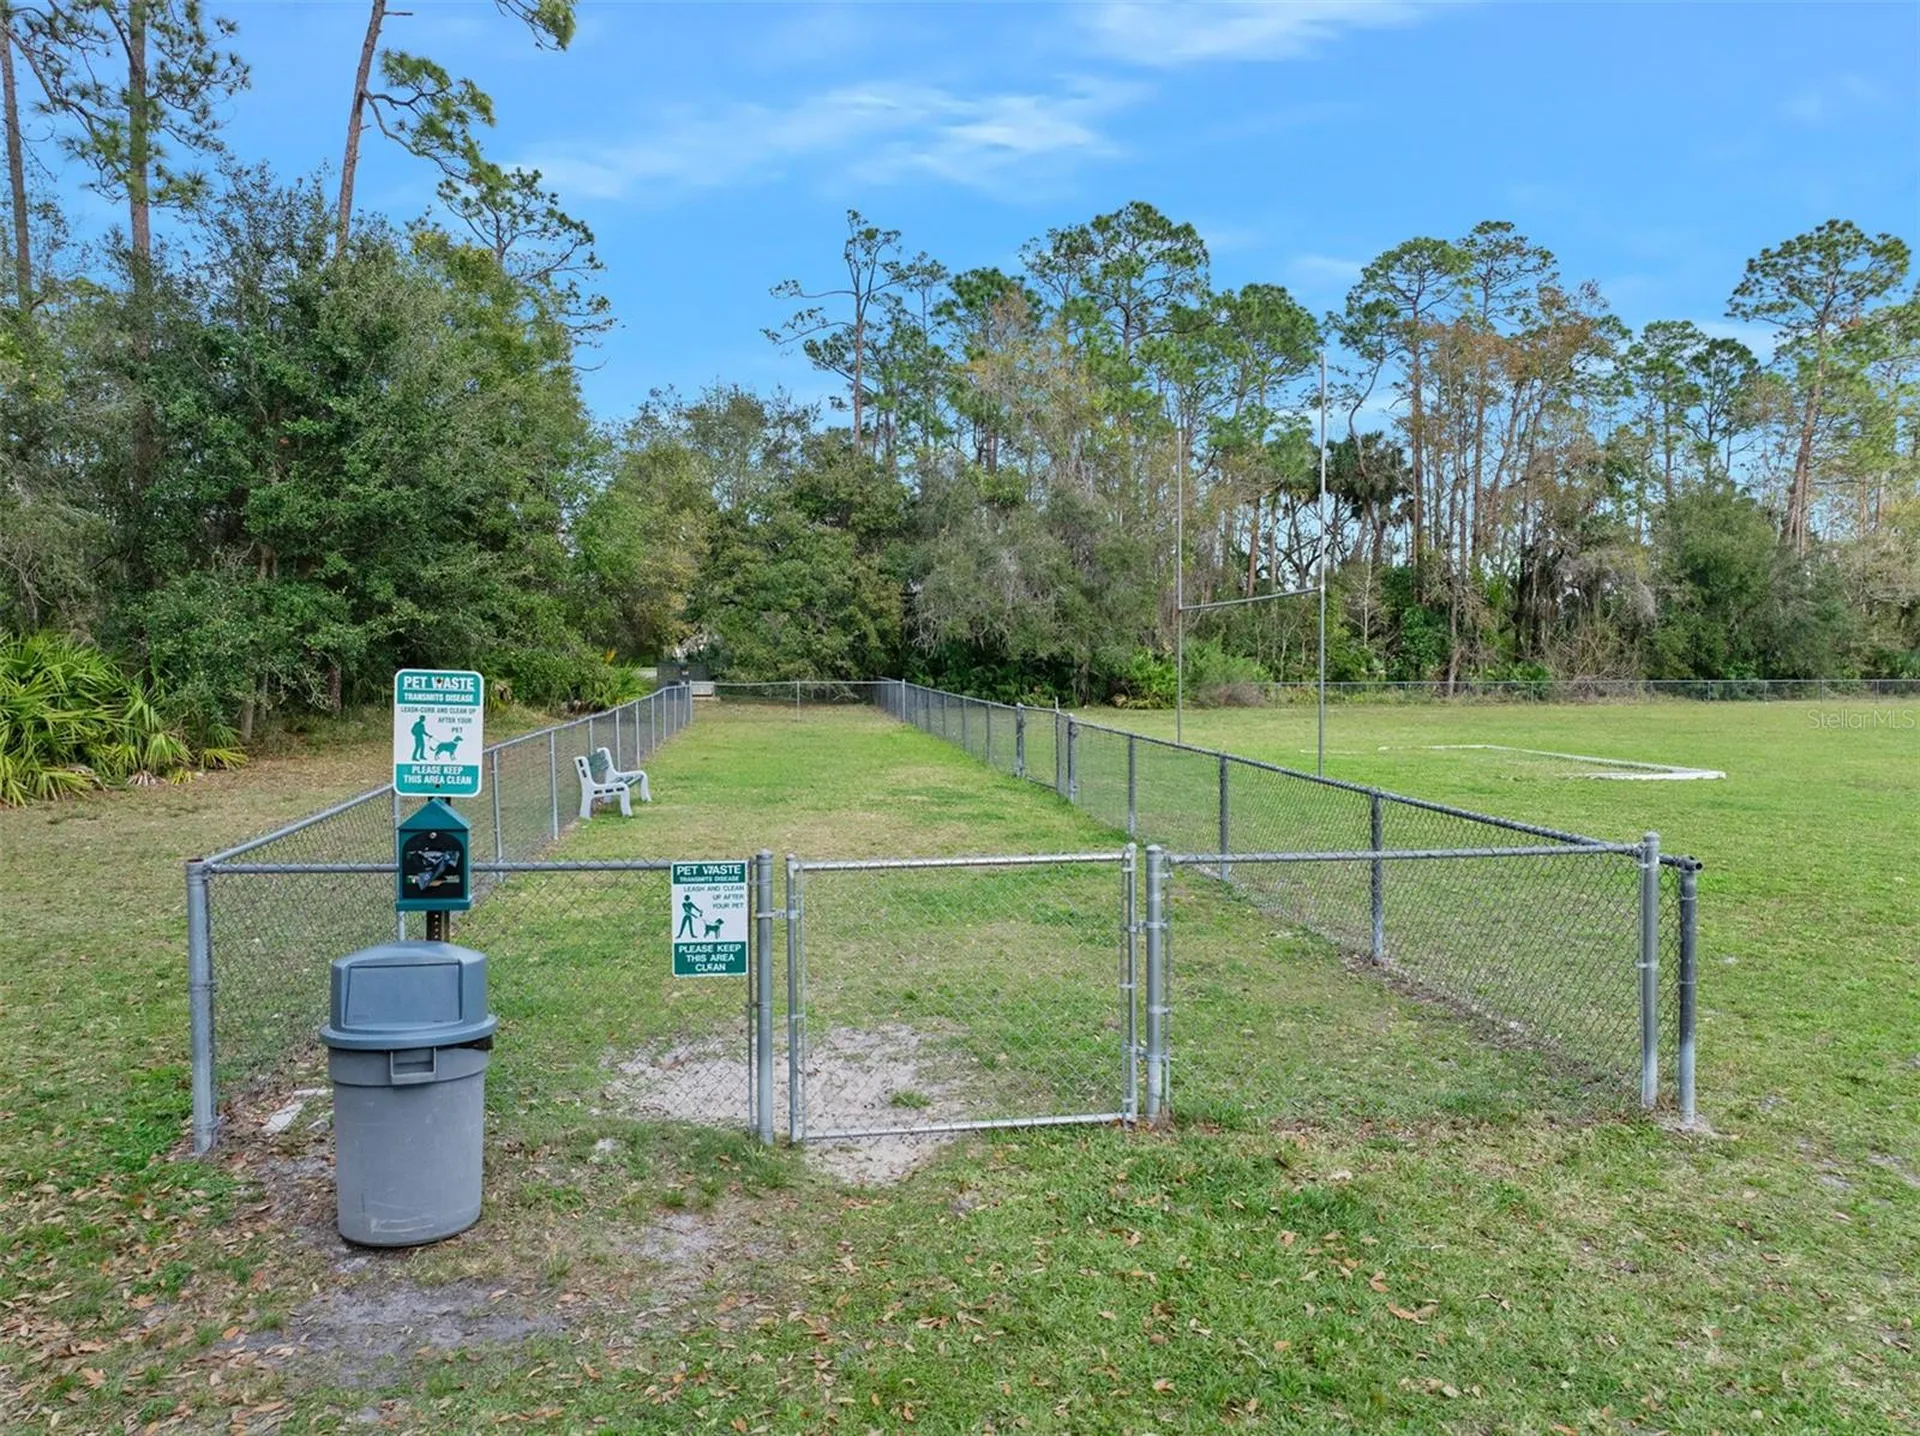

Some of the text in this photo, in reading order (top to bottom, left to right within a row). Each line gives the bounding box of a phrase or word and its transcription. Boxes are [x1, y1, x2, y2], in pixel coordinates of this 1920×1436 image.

[404, 676, 475, 691] PET WASTE
[404, 693, 474, 702] TRANSMITS DISEASE
[412, 765, 463, 775] PLEASE KEEP
[404, 775, 472, 784] THIS AREA CLEAN
[677, 865, 741, 875] PET WASTE
[679, 944, 741, 953] PLEASE KEEP
[710, 954, 735, 962] AREA
[695, 963, 726, 971] CLEAN
